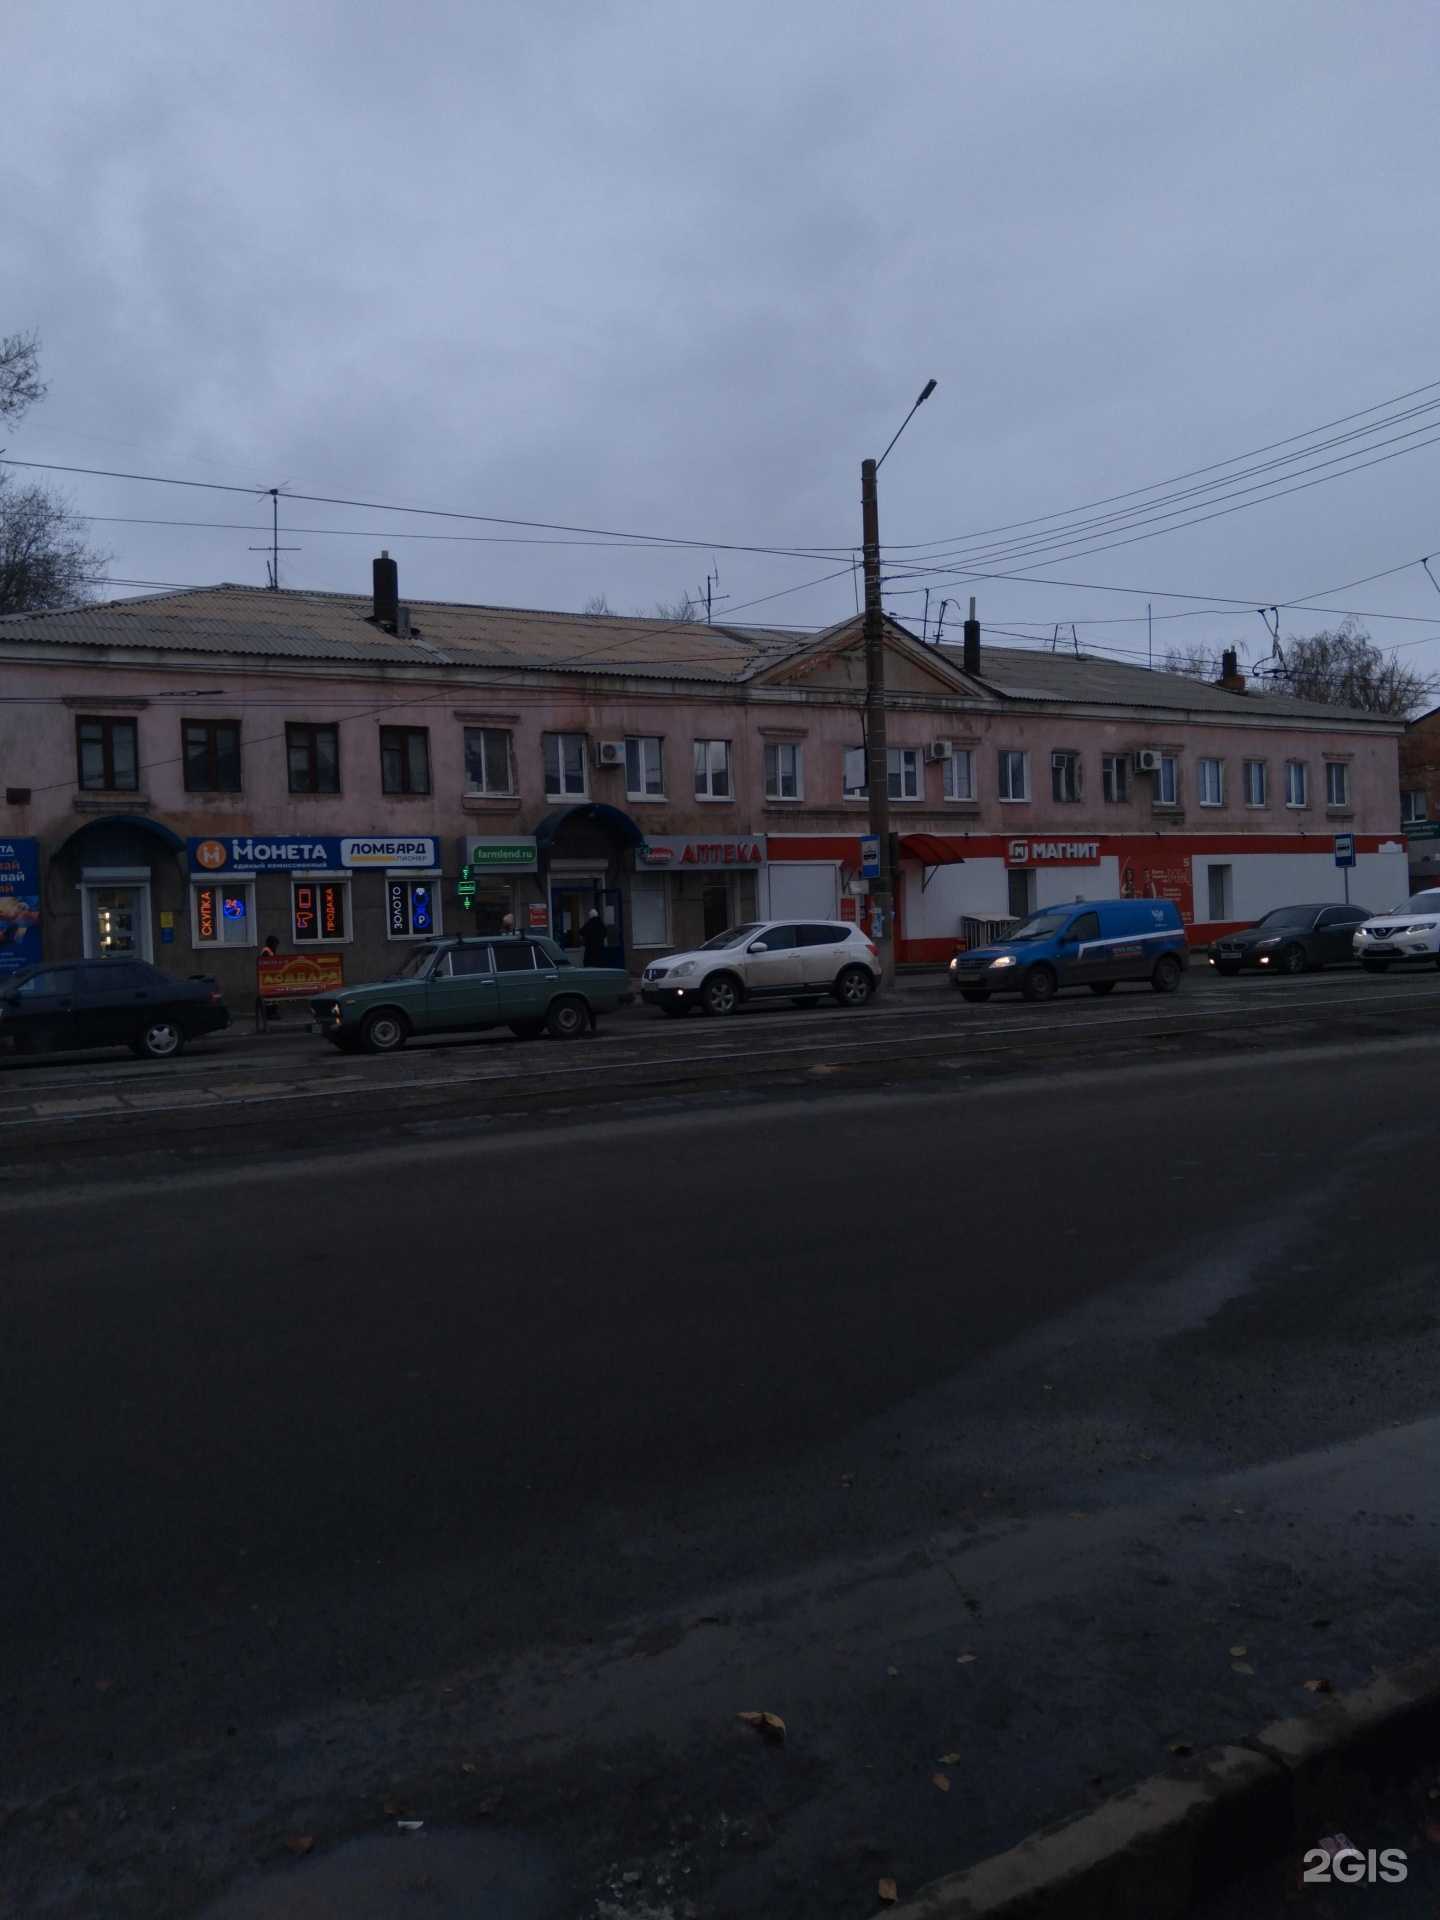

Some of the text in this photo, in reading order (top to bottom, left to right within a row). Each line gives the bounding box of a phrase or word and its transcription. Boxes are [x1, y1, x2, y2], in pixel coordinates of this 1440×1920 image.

[232, 839, 328, 861] МОНЕТА
[350, 843, 426, 855] ЛОМБАРД
[478, 849, 532, 859] farmlend.ru
[679, 843, 762, 864] АПТЕКА
[1032, 842, 1100, 859] МАГНИТ
[201, 890, 213, 936] СКУПКА
[323, 887, 337, 933] ПРОДАЖА
[392, 886, 403, 928] ЗОЛОТО
